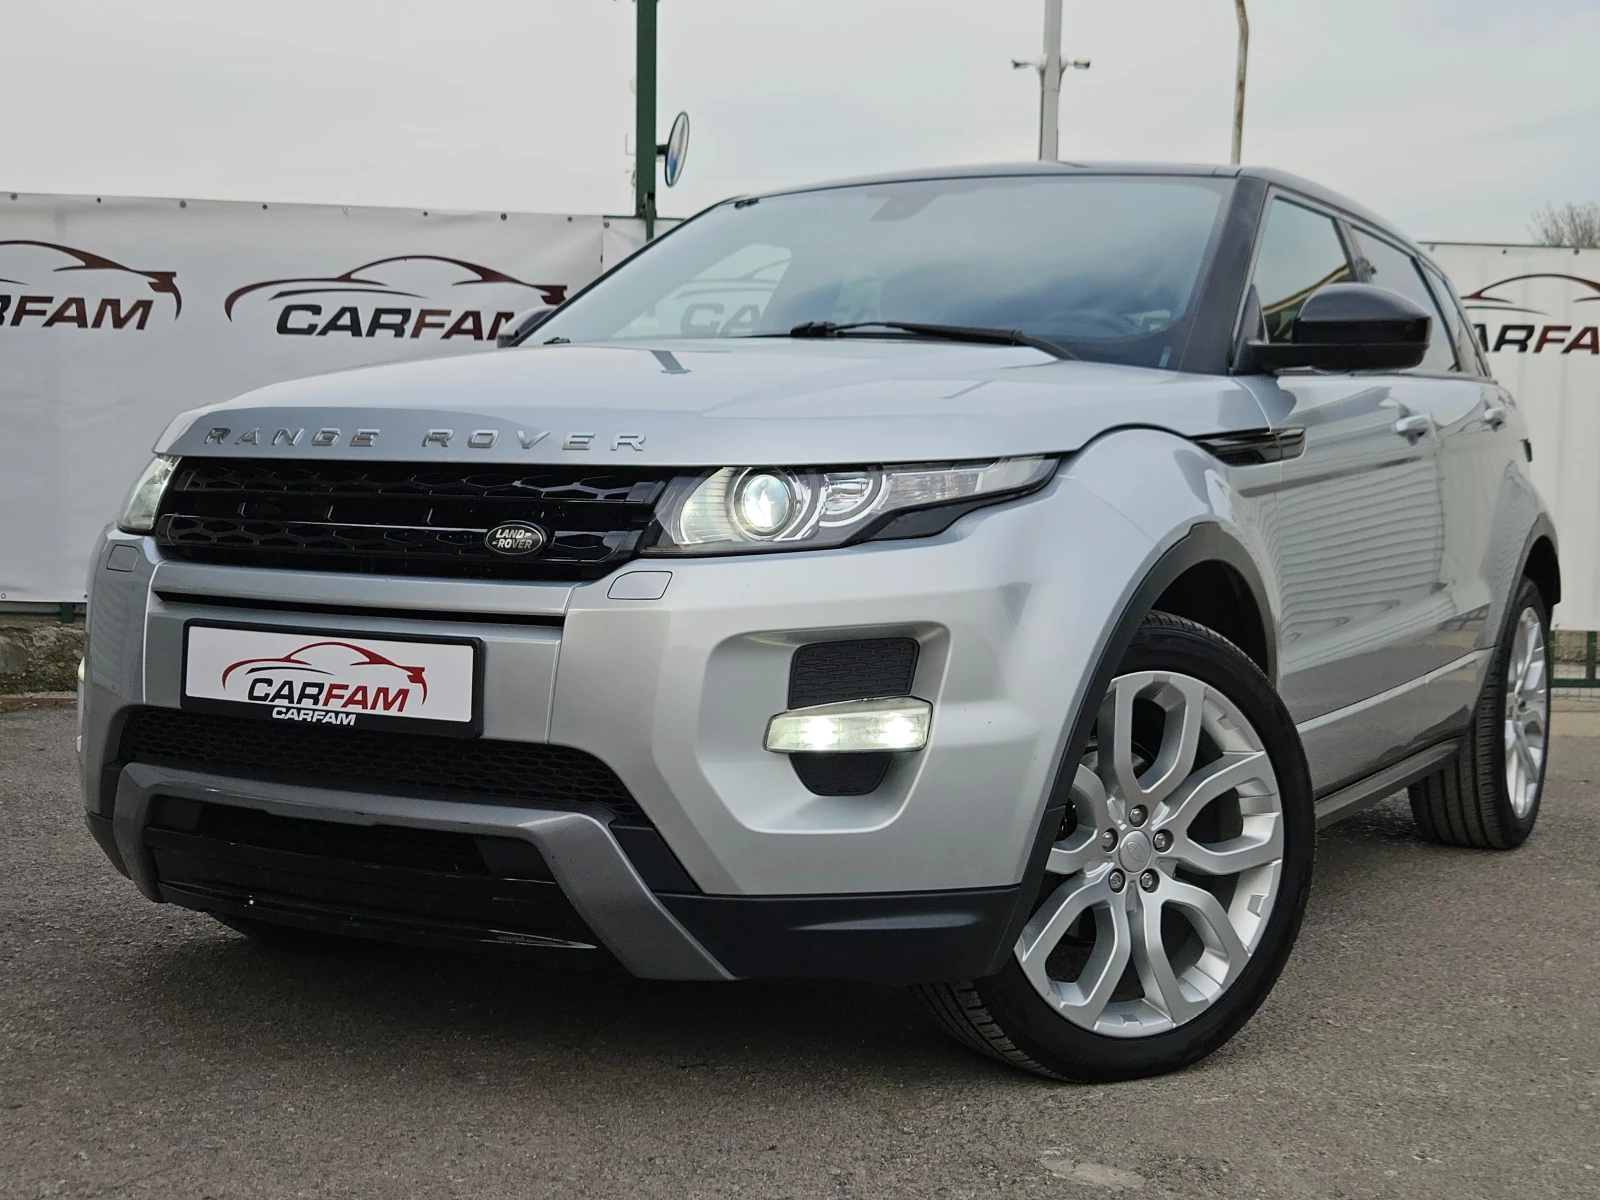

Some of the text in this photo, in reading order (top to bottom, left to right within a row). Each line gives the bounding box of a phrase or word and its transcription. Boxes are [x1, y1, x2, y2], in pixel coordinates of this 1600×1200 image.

[203, 427, 647, 452] RANGE ROVER
[495, 529, 525, 539] LAND
[497, 538, 533, 549] ROVER
[248, 678, 410, 712] CARFAM
[272, 707, 356, 726] CARFAM
